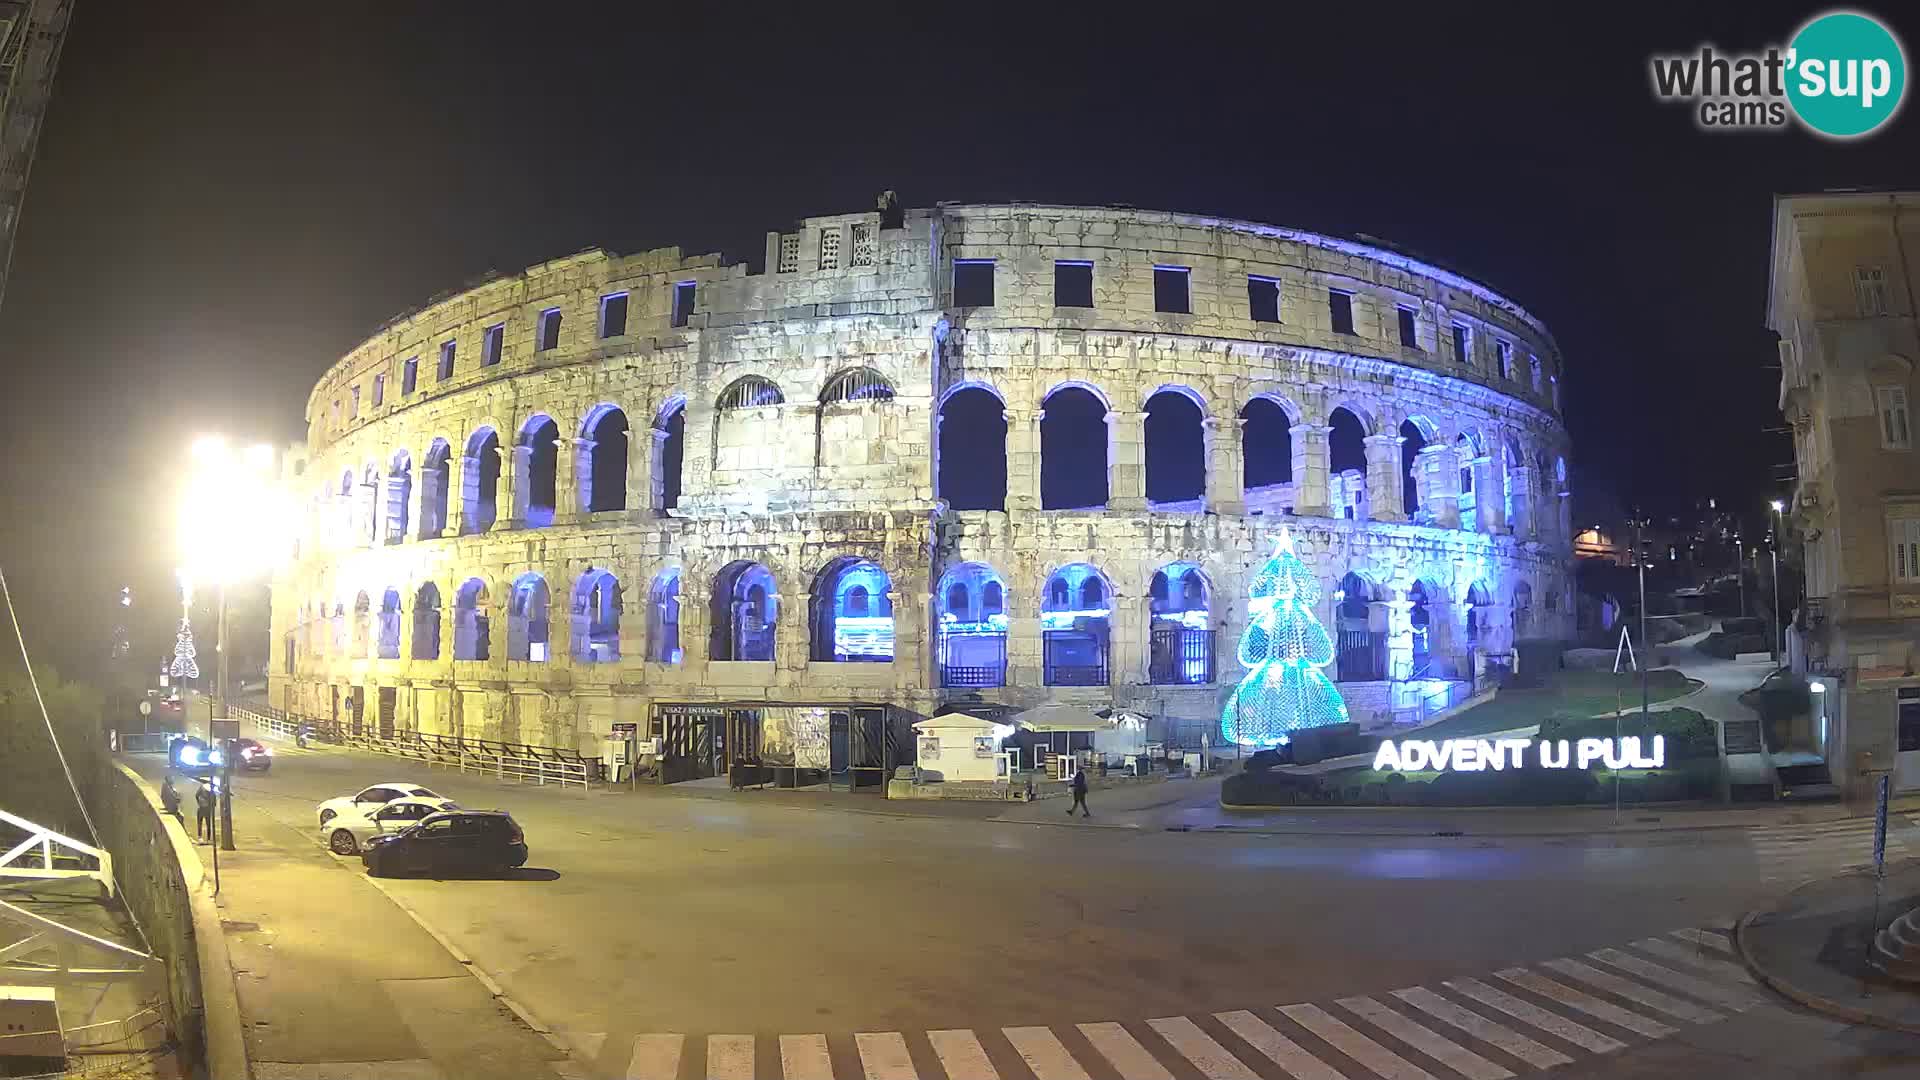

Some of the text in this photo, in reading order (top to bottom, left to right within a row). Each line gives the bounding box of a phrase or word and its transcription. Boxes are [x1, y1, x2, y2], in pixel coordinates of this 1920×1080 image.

[1372, 734, 1666, 771] ADVENT U PULI
